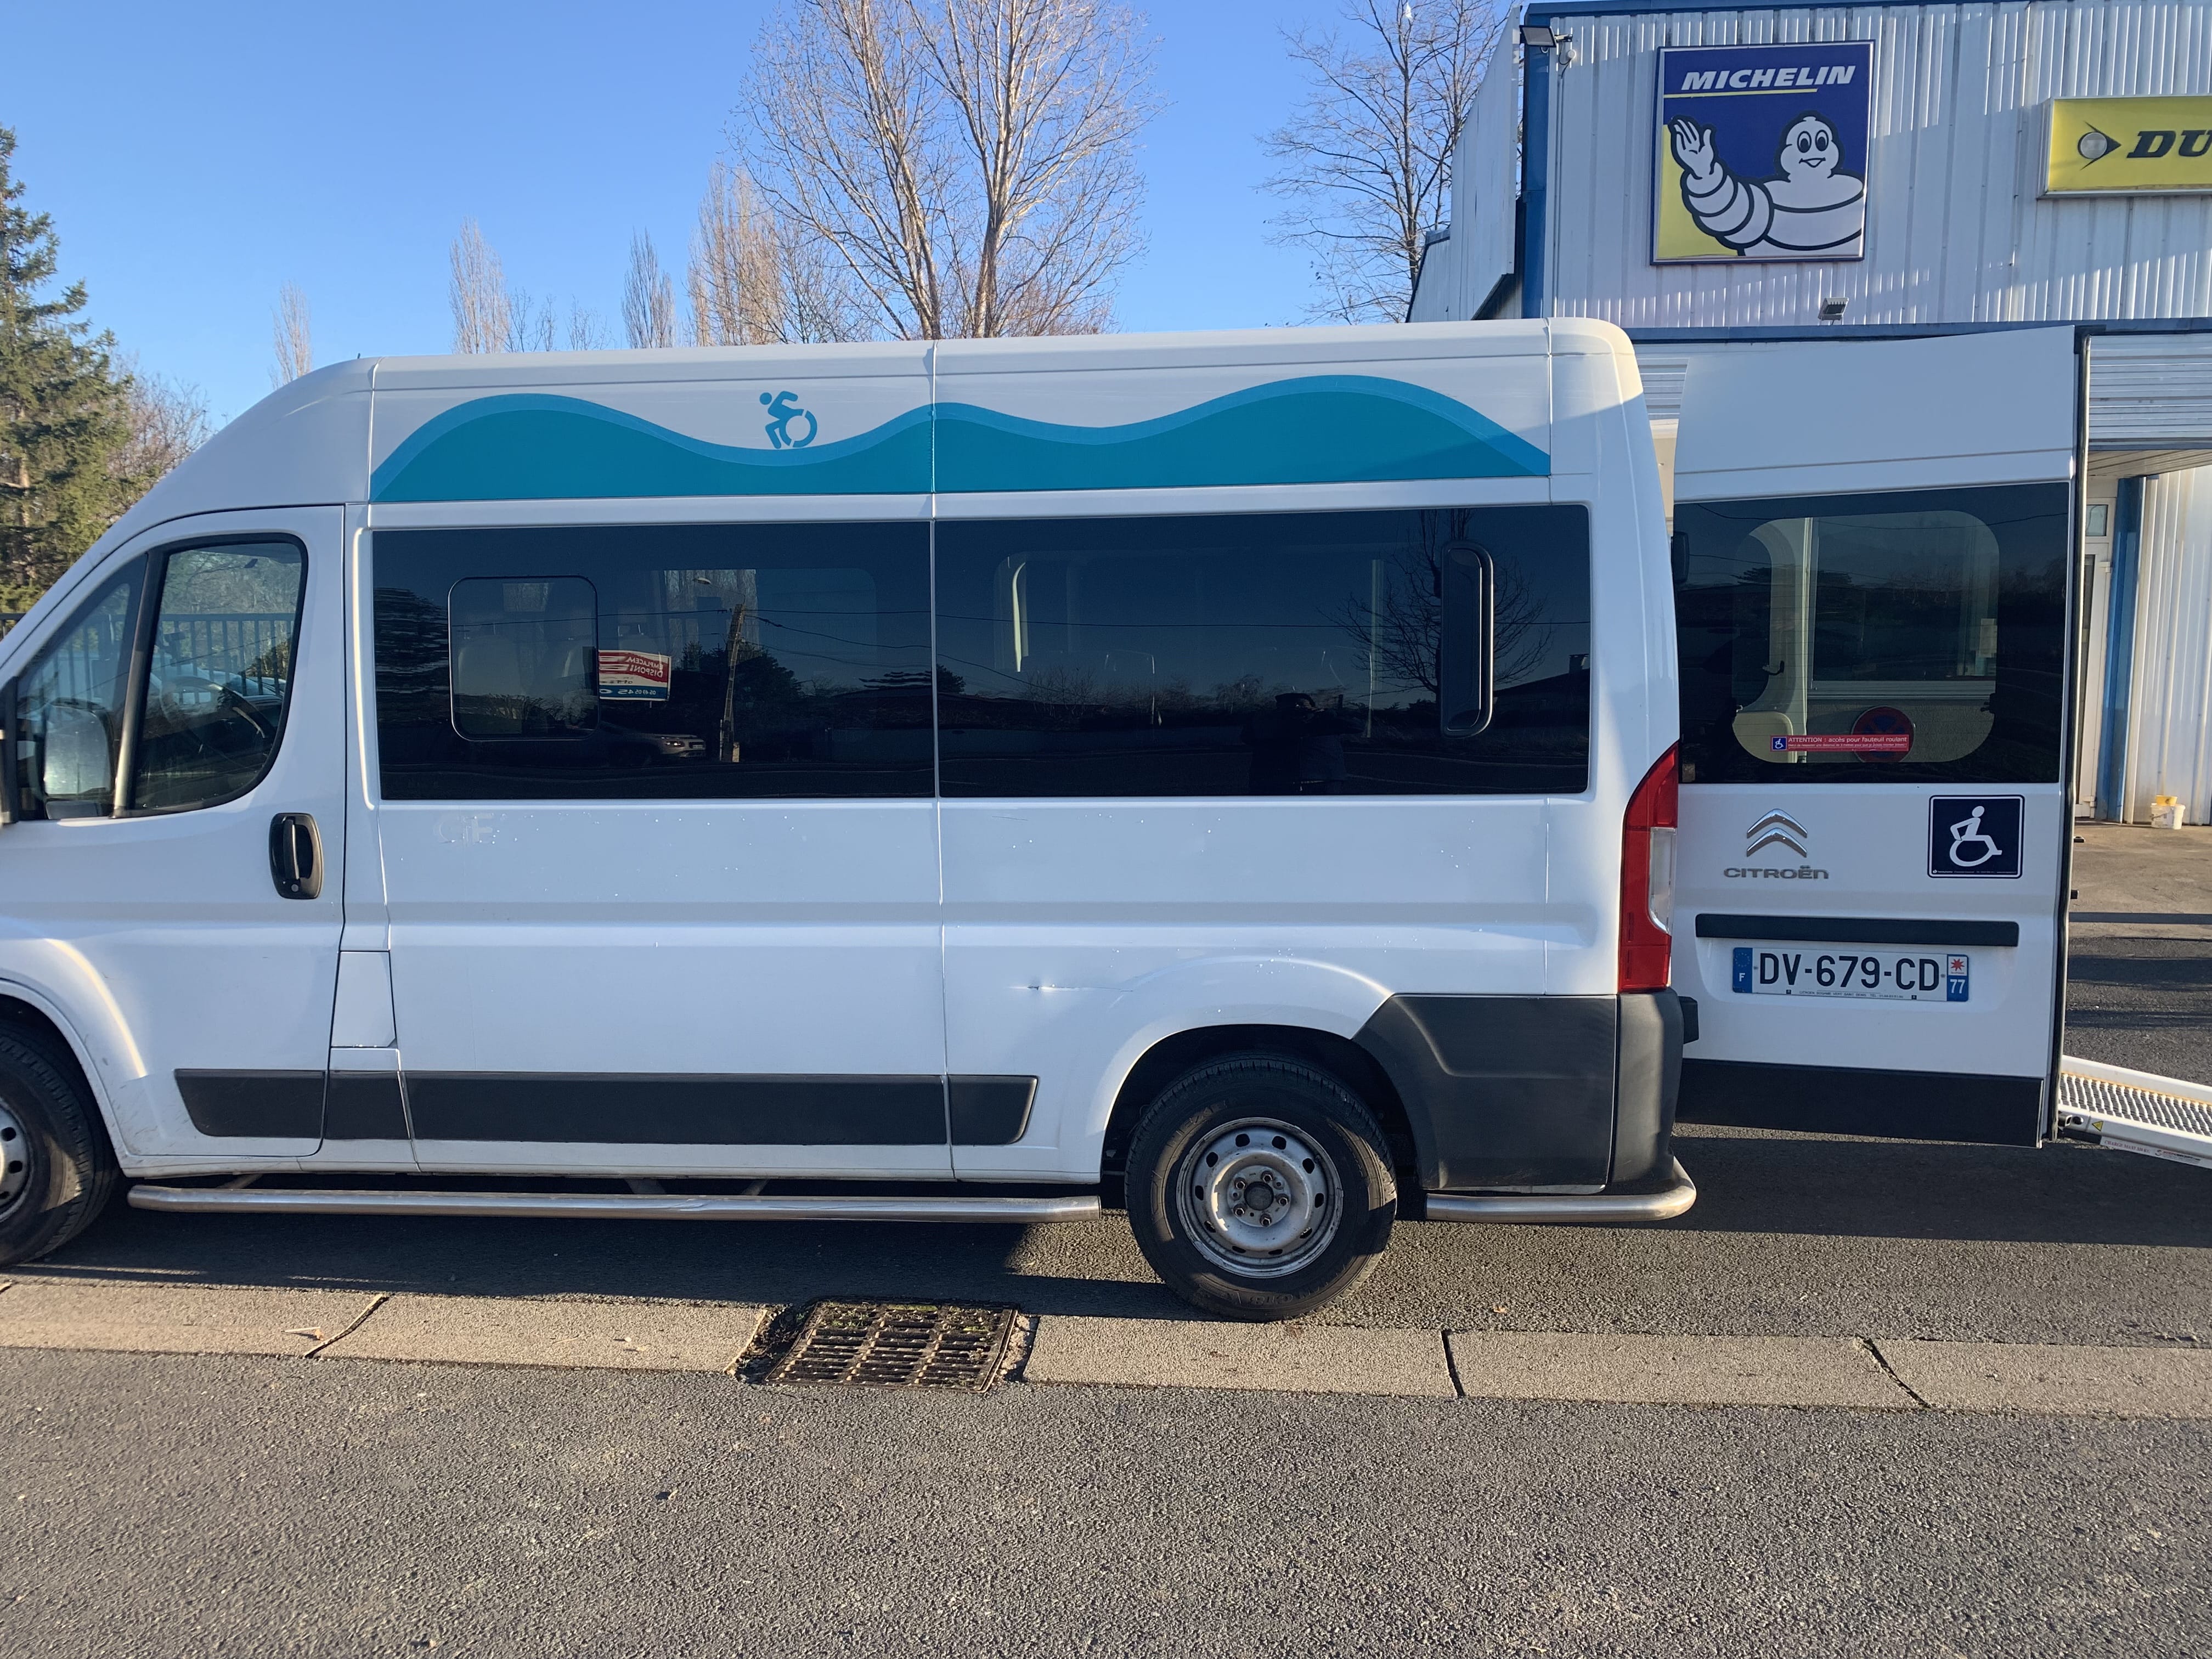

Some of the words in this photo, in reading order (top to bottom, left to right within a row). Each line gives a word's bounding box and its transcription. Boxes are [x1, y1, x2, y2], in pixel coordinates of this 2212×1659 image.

[1681, 65, 1855, 91] MICHELIN
[2126, 129, 2212, 159] DU
[1739, 973, 1746, 982] F
[1760, 953, 1939, 991] DV-679-CD
[1950, 979, 1966, 994] 77
